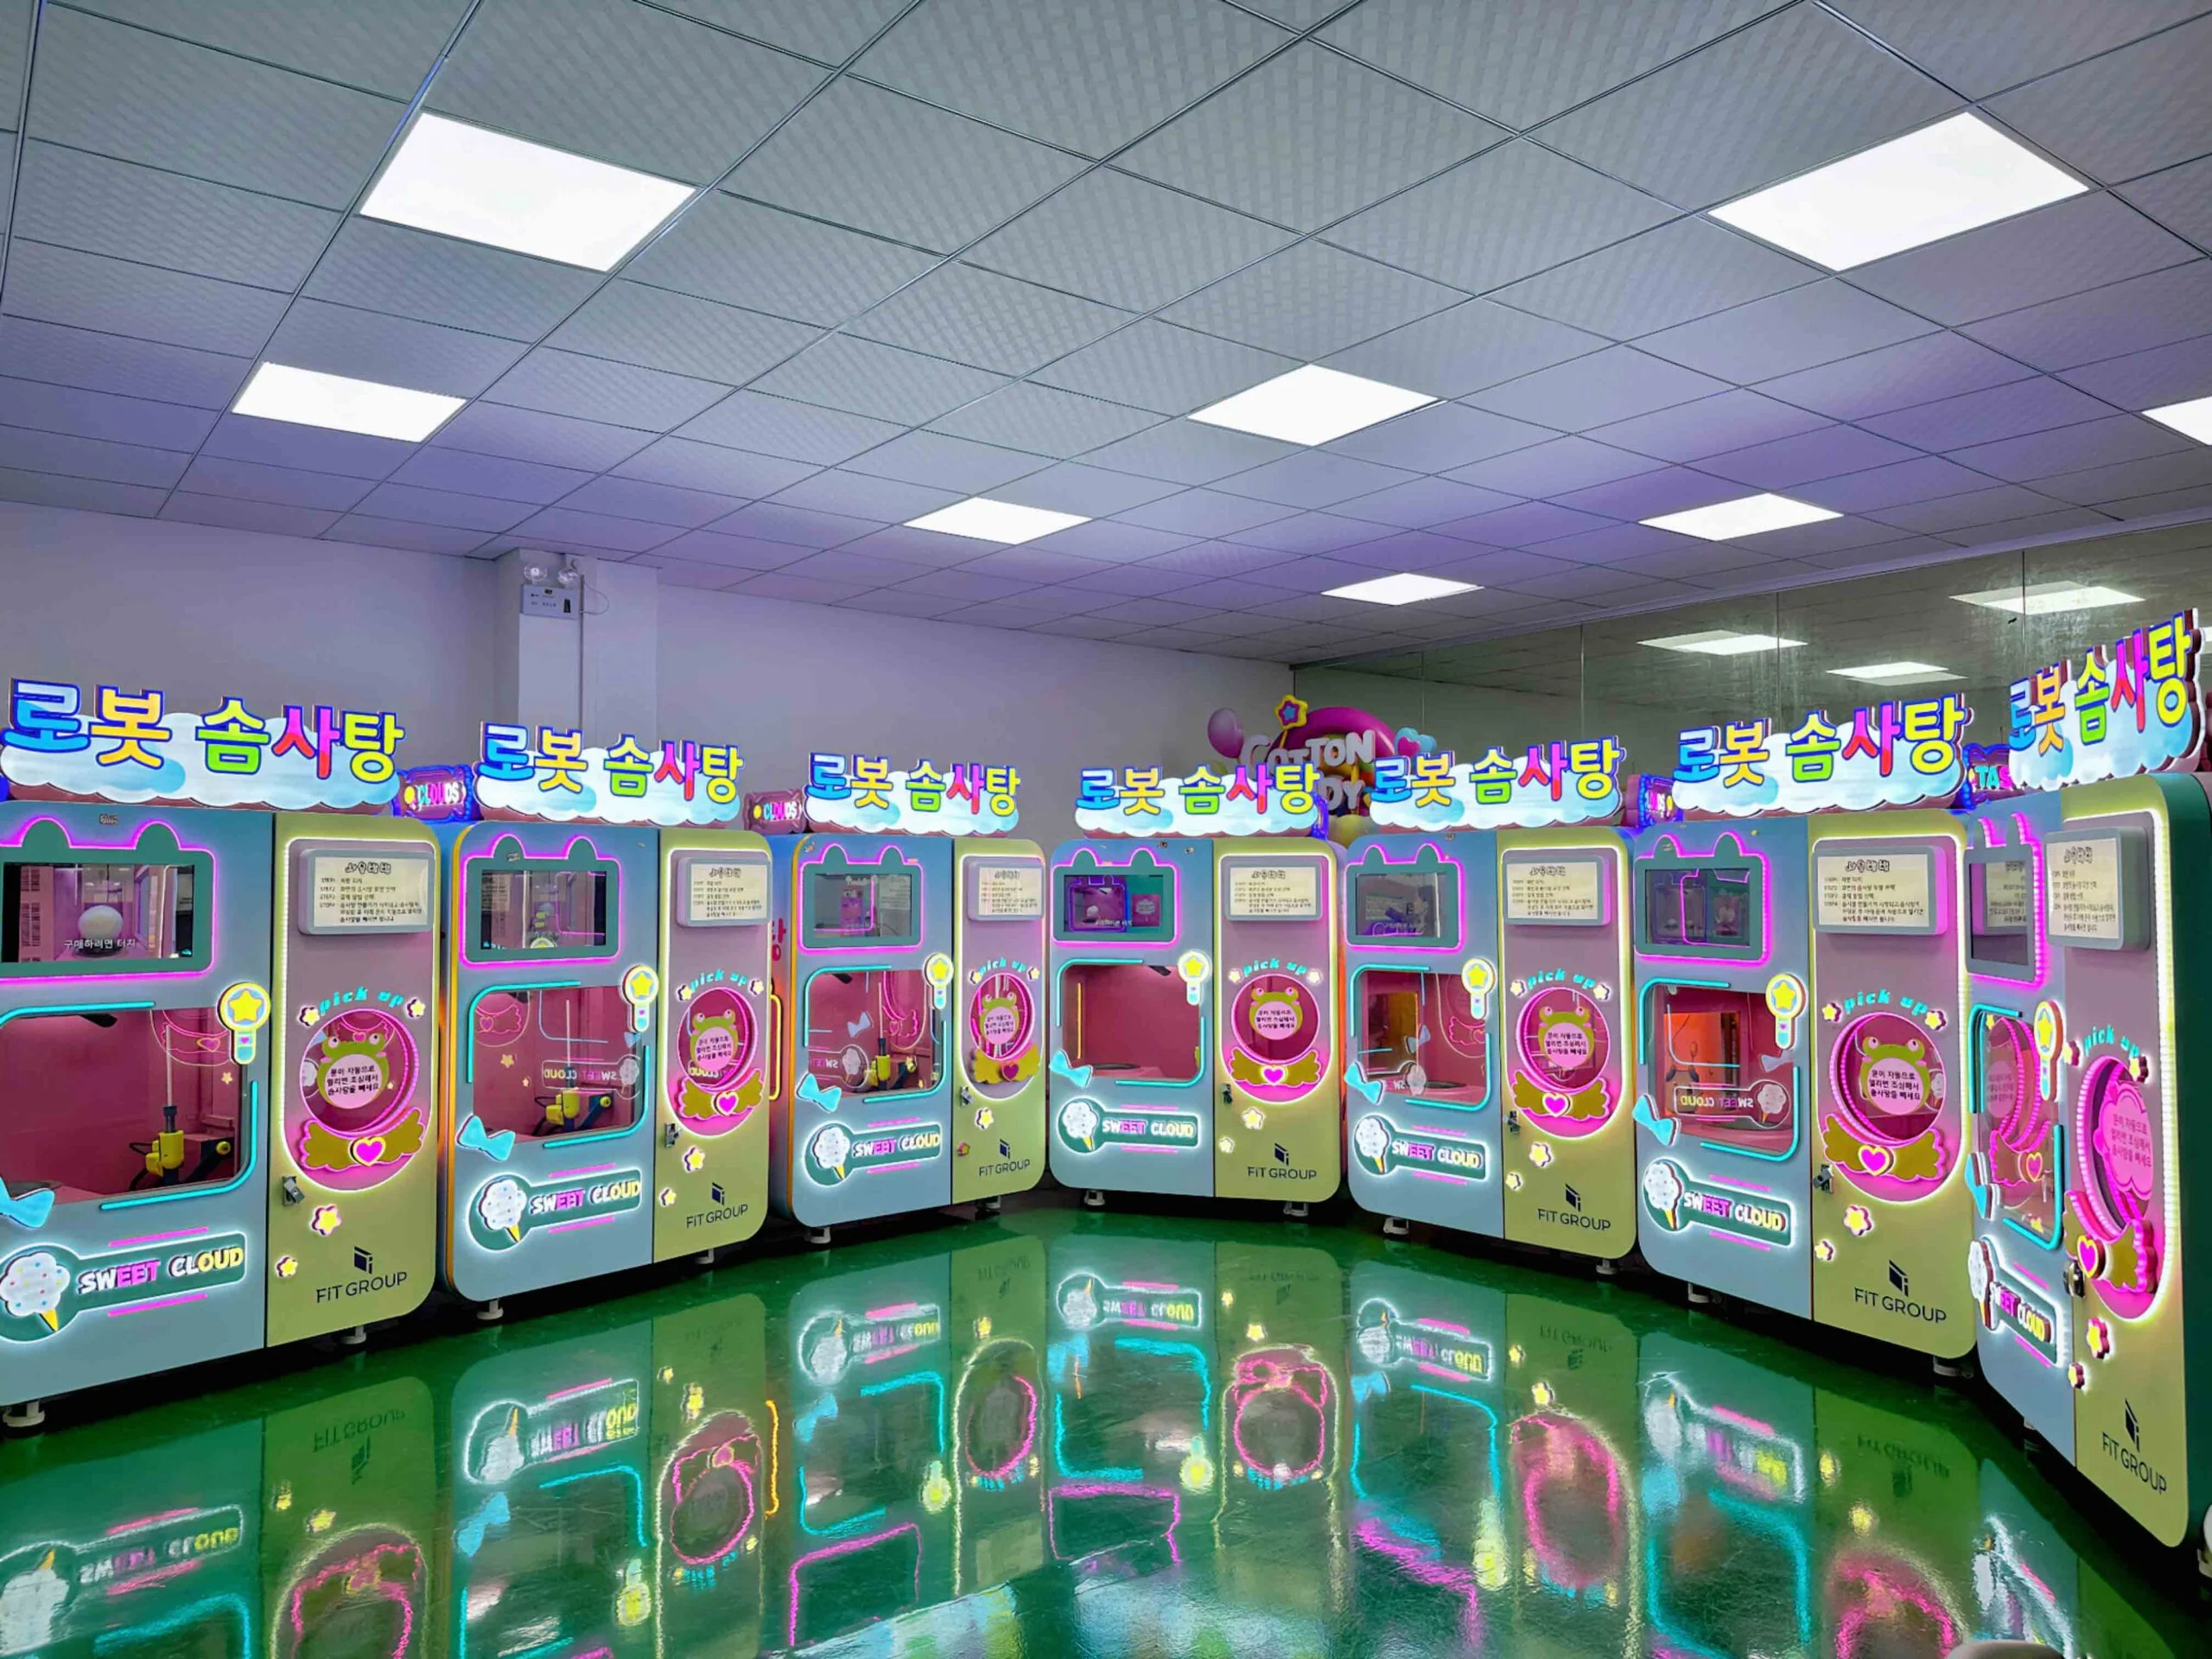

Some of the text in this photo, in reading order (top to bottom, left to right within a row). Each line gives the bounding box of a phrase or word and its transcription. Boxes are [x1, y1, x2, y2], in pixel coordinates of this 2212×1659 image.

[2009, 611, 2195, 757] 로봇 솜사탕
[2, 677, 404, 785] 로봇 솜사탕
[1673, 694, 1968, 788] 로봇 솜사탕
[479, 721, 744, 804] 로봇 솜사탕
[1370, 735, 1624, 808] 로봇 솜사탕
[804, 753, 1020, 817] 로봇 솜사탕
[1076, 760, 1321, 816] 로봇 솜사탕
[1011, 961, 1027, 972] up
[1243, 957, 1307, 977] pick up
[1528, 968, 1596, 990] pick up
[690, 969, 748, 993] pick up
[319, 986, 404, 1016] pick up
[1844, 988, 1928, 1015] pick up
[2084, 1024, 2140, 1059] pick up
[1102, 1120, 1195, 1137] SWEET CLOUD
[854, 1133, 940, 1158] SWEET CLOUD
[1392, 1141, 1483, 1168] SWEET CLOUD
[995, 1159, 1030, 1173] GROUP
[1268, 1167, 1317, 1179] GROUP
[530, 1180, 641, 1214] SWEET CLOUD
[705, 1205, 747, 1224] GROUP
[1560, 1212, 1611, 1231] GROUP
[1684, 1192, 1786, 1232] SWEET CLOUD
[78, 1247, 244, 1294] SWEET CLOUD
[346, 1271, 407, 1297] GROUP
[1882, 1296, 1946, 1324] GROUP
[2120, 1448, 2166, 1493] GROUP
